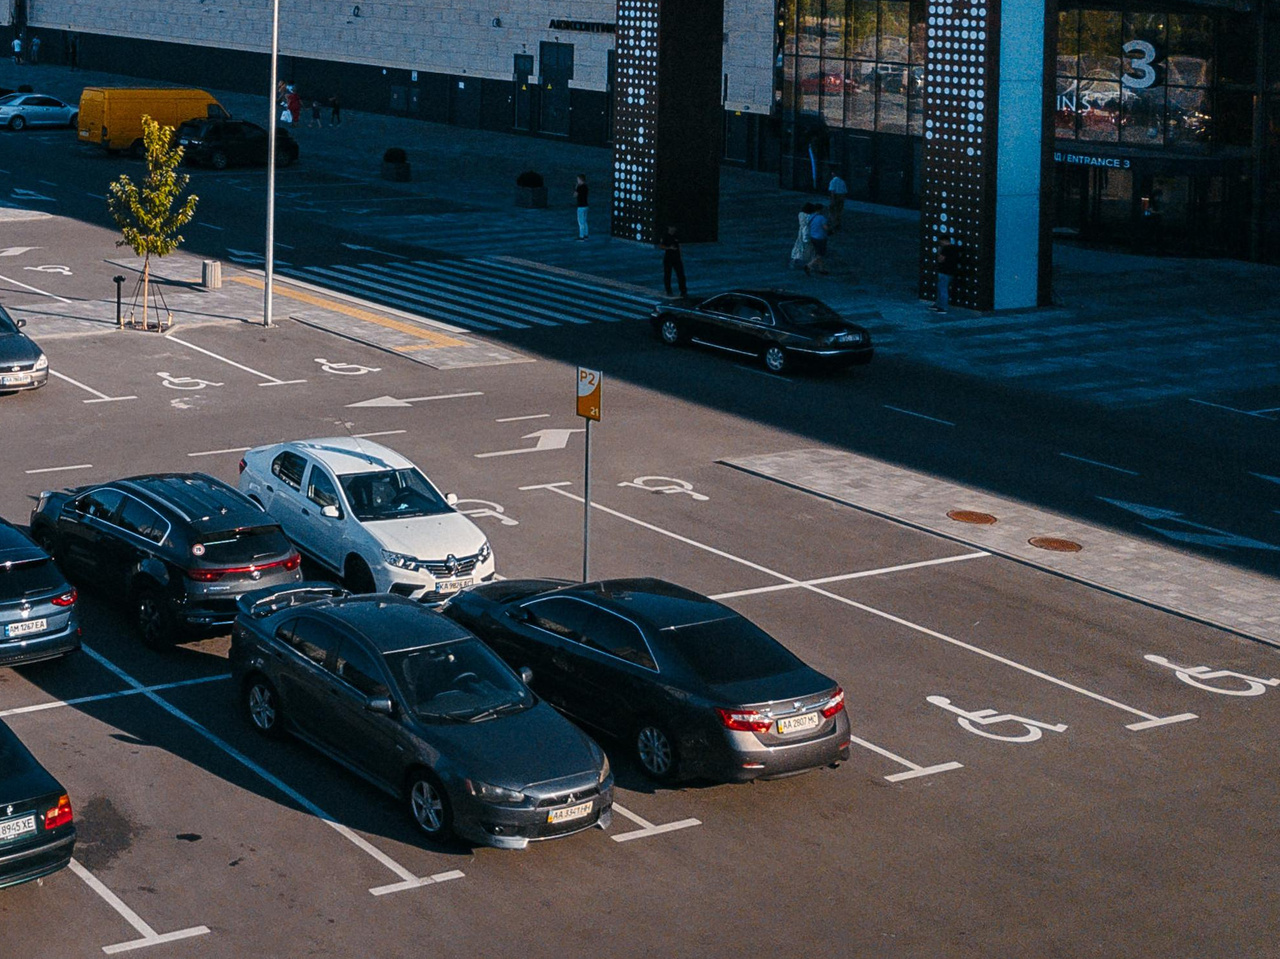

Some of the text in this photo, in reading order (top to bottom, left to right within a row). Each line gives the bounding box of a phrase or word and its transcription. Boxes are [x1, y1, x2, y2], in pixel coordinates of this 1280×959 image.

[1121, 40, 1156, 89] 3
[1067, 154, 1120, 168] ENTRANCE
[1123, 160, 1130, 168] 3
[580, 370, 595, 386] P2
[590, 406, 599, 416] 21
[21, 623, 34, 631] 1267
[783, 721, 793, 730] AA
[1, 822, 21, 835] 8945
[22, 818, 34, 828] XE
